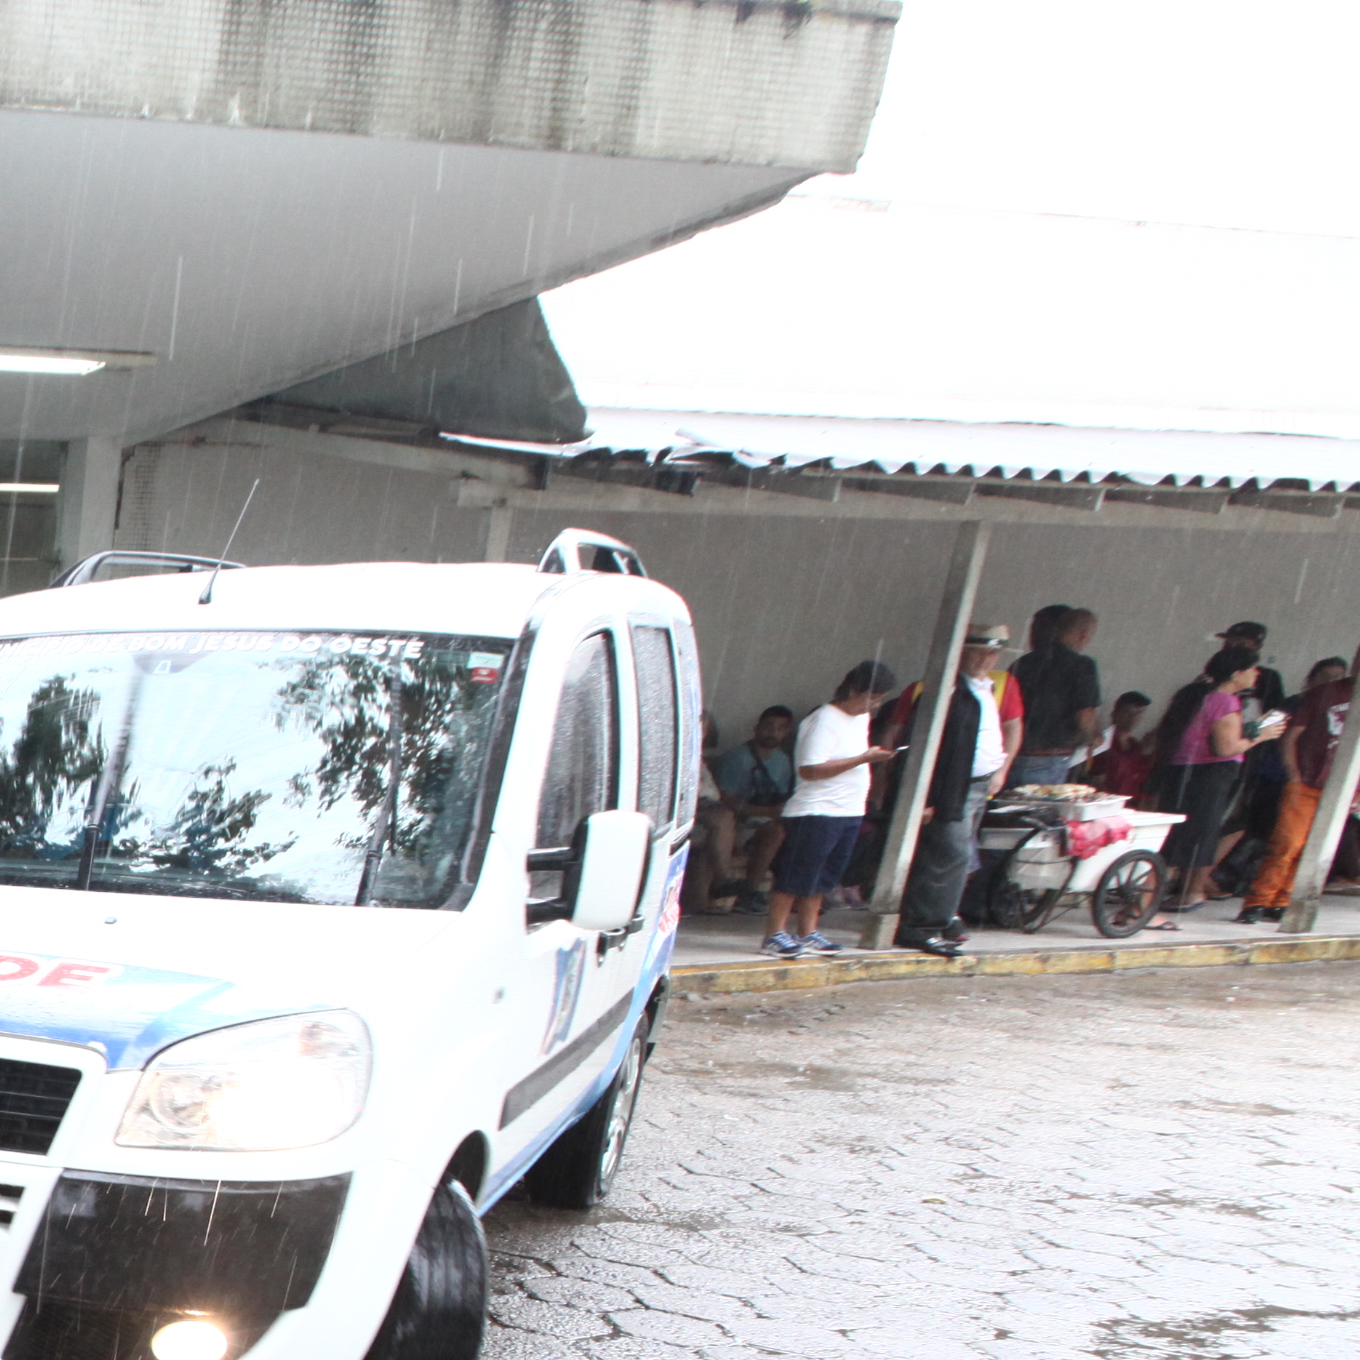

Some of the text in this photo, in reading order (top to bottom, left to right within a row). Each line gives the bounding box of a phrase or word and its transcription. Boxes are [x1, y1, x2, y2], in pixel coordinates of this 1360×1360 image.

[88, 635, 123, 652] DE
[127, 635, 188, 652] BOM
[189, 635, 273, 654] JESUS
[279, 636, 322, 652] DO
[329, 636, 425, 659] OESTE
